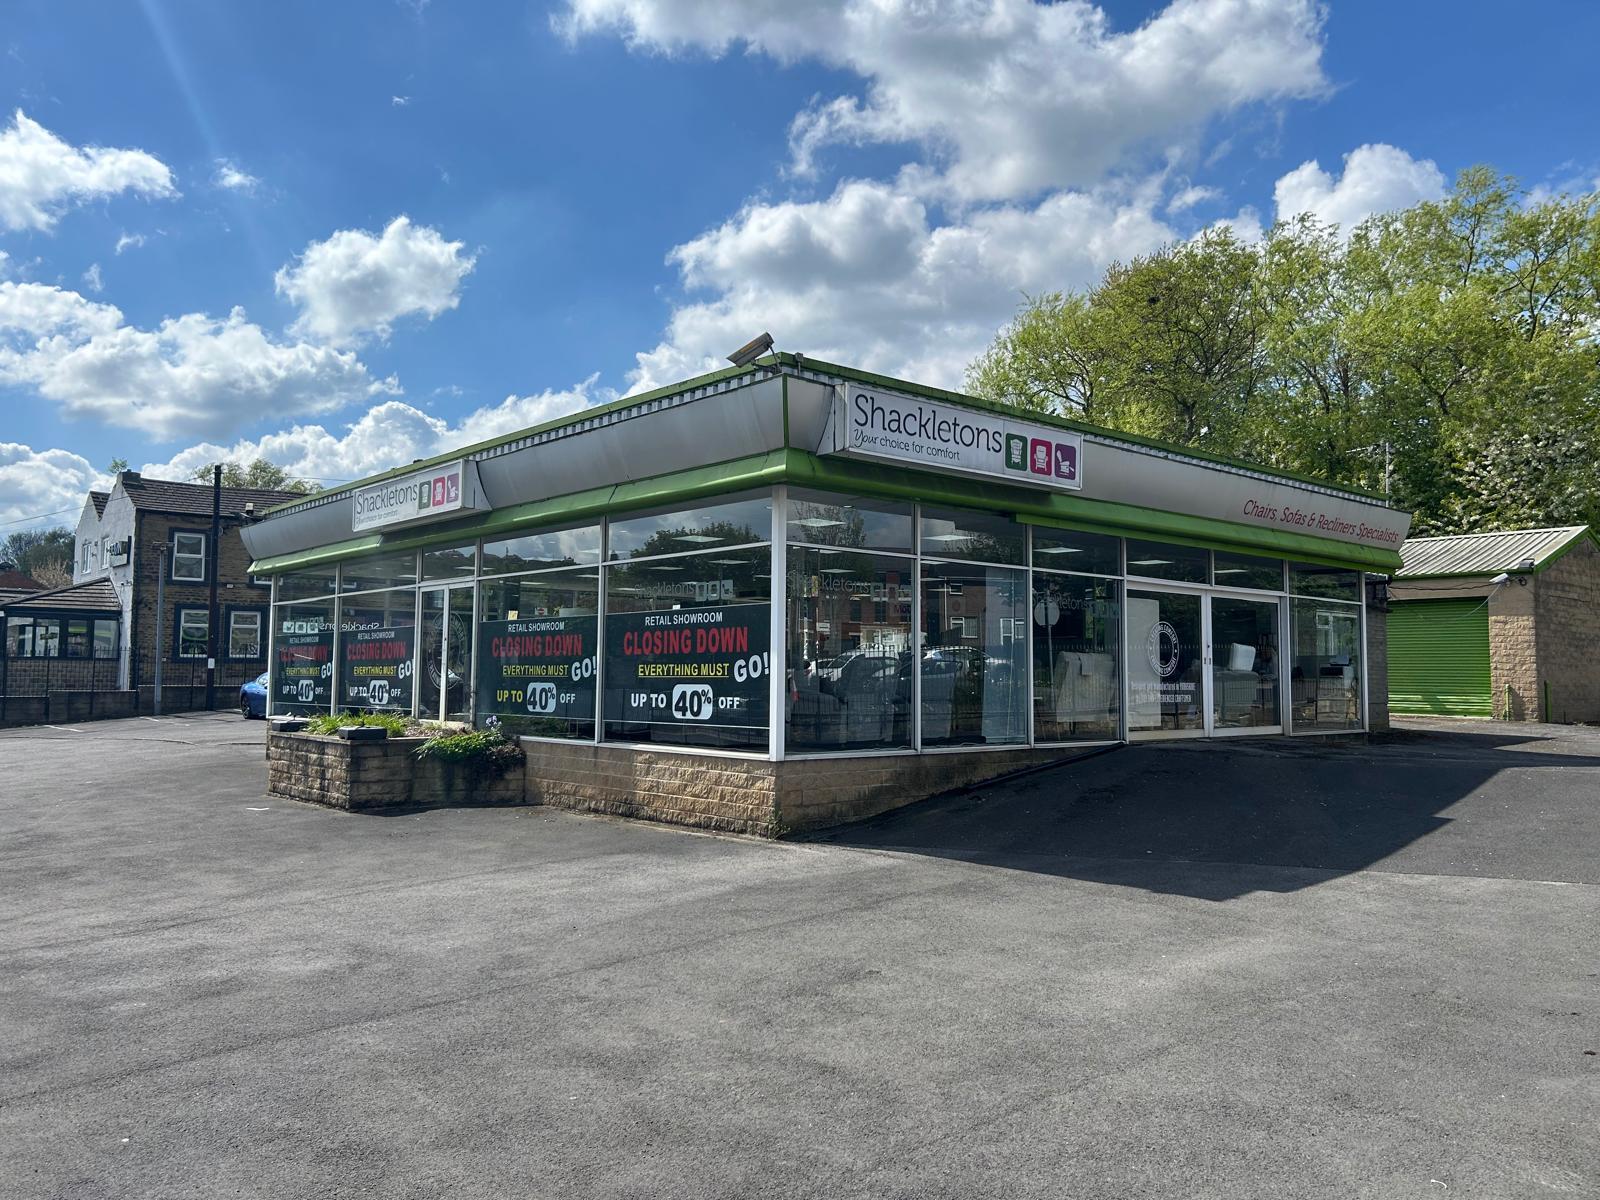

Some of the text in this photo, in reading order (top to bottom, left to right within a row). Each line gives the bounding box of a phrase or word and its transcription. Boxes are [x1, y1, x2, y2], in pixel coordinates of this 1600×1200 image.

[854, 393, 1003, 454] Shackletons
[854, 428, 960, 461] Your choice for comfort
[356, 483, 418, 515] Shackletons
[1243, 500, 1399, 543] Chairs, Sofas & Recliners Specialists
[508, 621, 565, 633] RETAIL SHOWROOM
[645, 611, 723, 626] RETAIL SHOWROOM
[371, 631, 395, 639] SHOWROOM
[492, 635, 582, 657] CLOSING DOWN
[624, 626, 748, 656] CLOSING DOWN
[347, 641, 407, 661] CLOSING DOWN
[353, 666, 382, 676] EVERYTHING
[383, 666, 397, 675] MUST
[503, 656, 597, 681] EVERYTHING MUST GO!
[638, 651, 770, 682] EVERYTHING MUST GO!
[282, 685, 290, 695] UP
[290, 685, 297, 695] TO
[315, 686, 324, 695] OFF
[350, 683, 401, 703] UP TO 40% OFF
[497, 687, 576, 711] UP TO 40% OFF
[631, 690, 740, 718] UP TO 40% OFF
